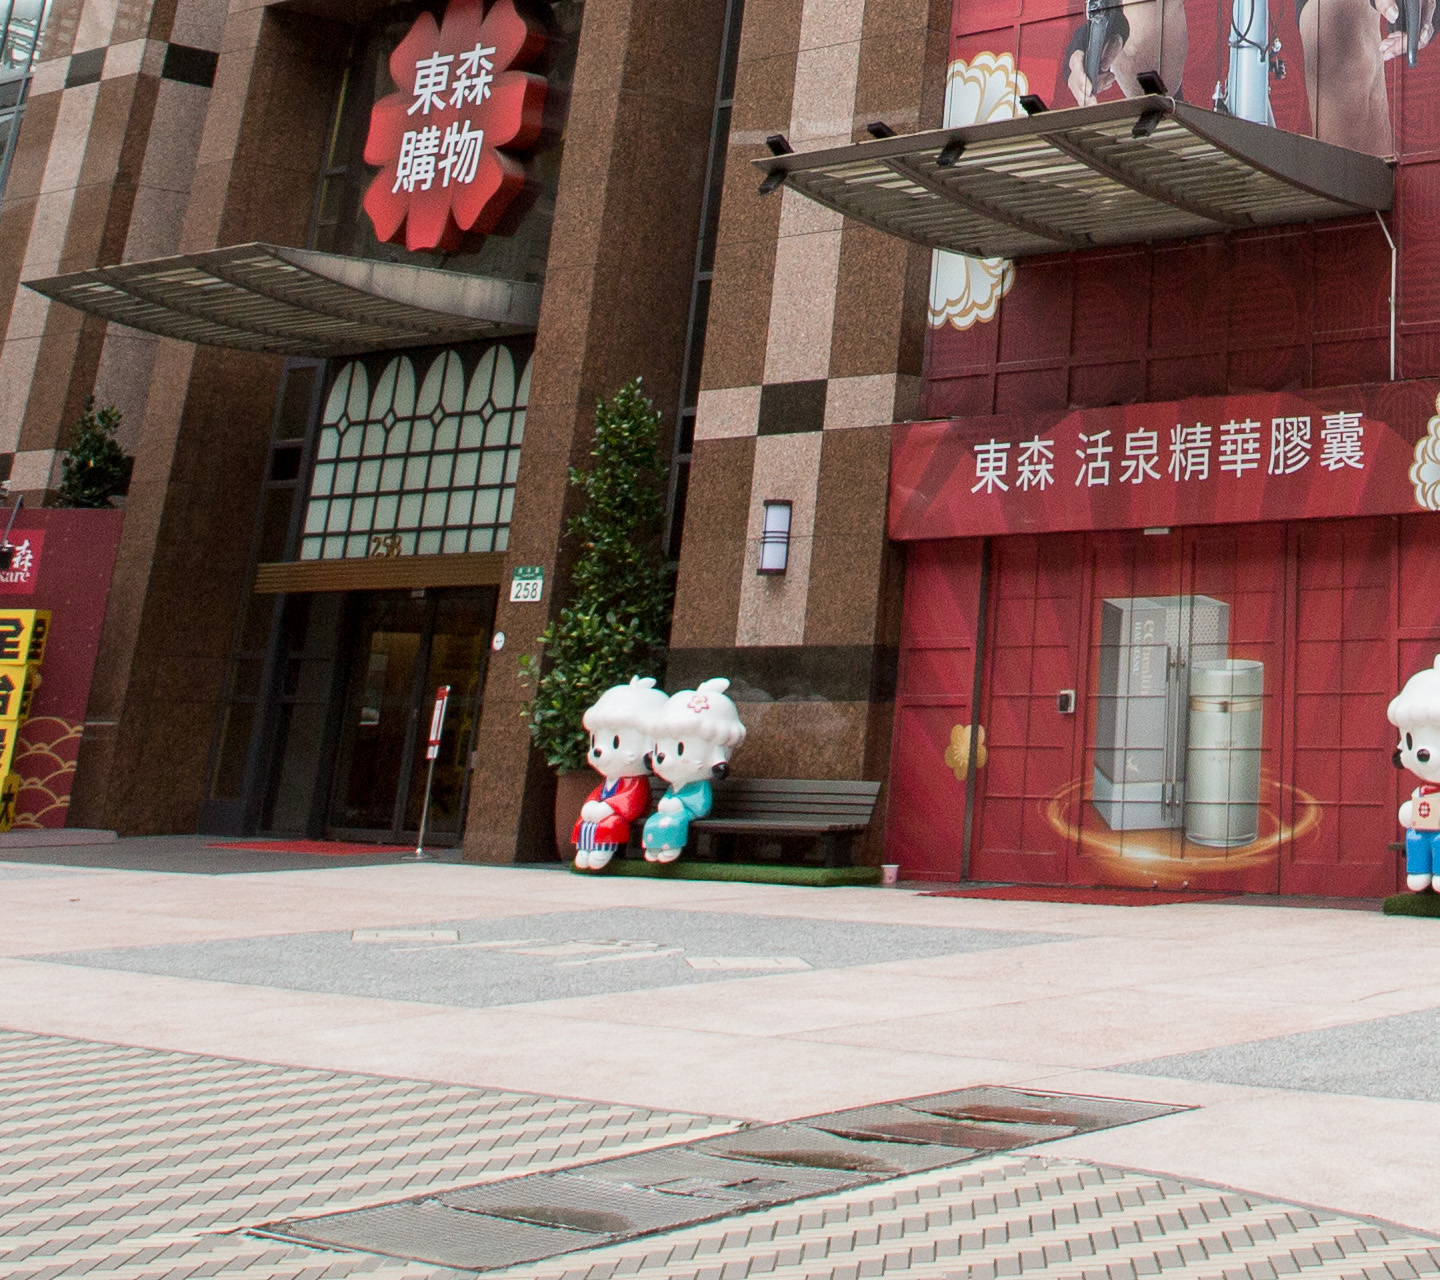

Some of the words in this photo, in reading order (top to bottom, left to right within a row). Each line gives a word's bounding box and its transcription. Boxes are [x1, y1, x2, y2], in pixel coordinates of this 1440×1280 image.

[407, 42, 497, 116] 東森
[392, 119, 484, 194] 購物
[971, 434, 1056, 496] 東森
[1074, 411, 1366, 490] 活泉精華膠囊
[371, 534, 403, 558] 258
[514, 582, 538, 599] 258
